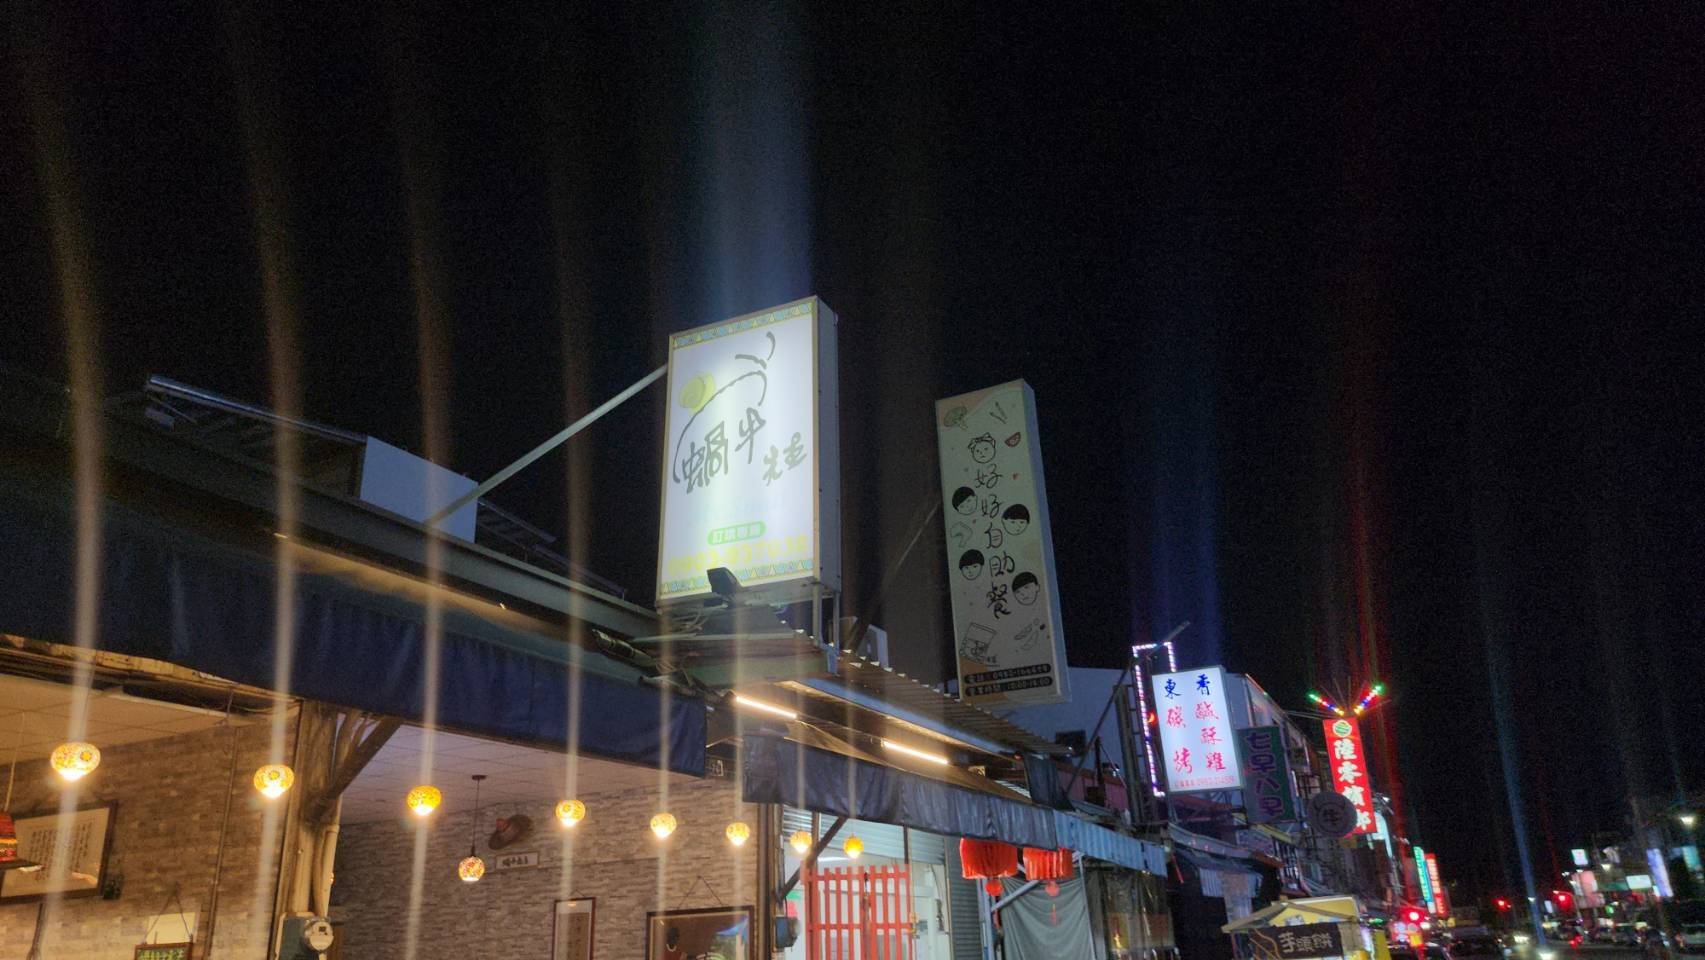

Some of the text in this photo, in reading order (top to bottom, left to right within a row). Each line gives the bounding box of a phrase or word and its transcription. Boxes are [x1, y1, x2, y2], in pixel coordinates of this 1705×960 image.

[974, 463, 1015, 619] 好好自助餐
[1278, 931, 1333, 954] 芋頭餅
